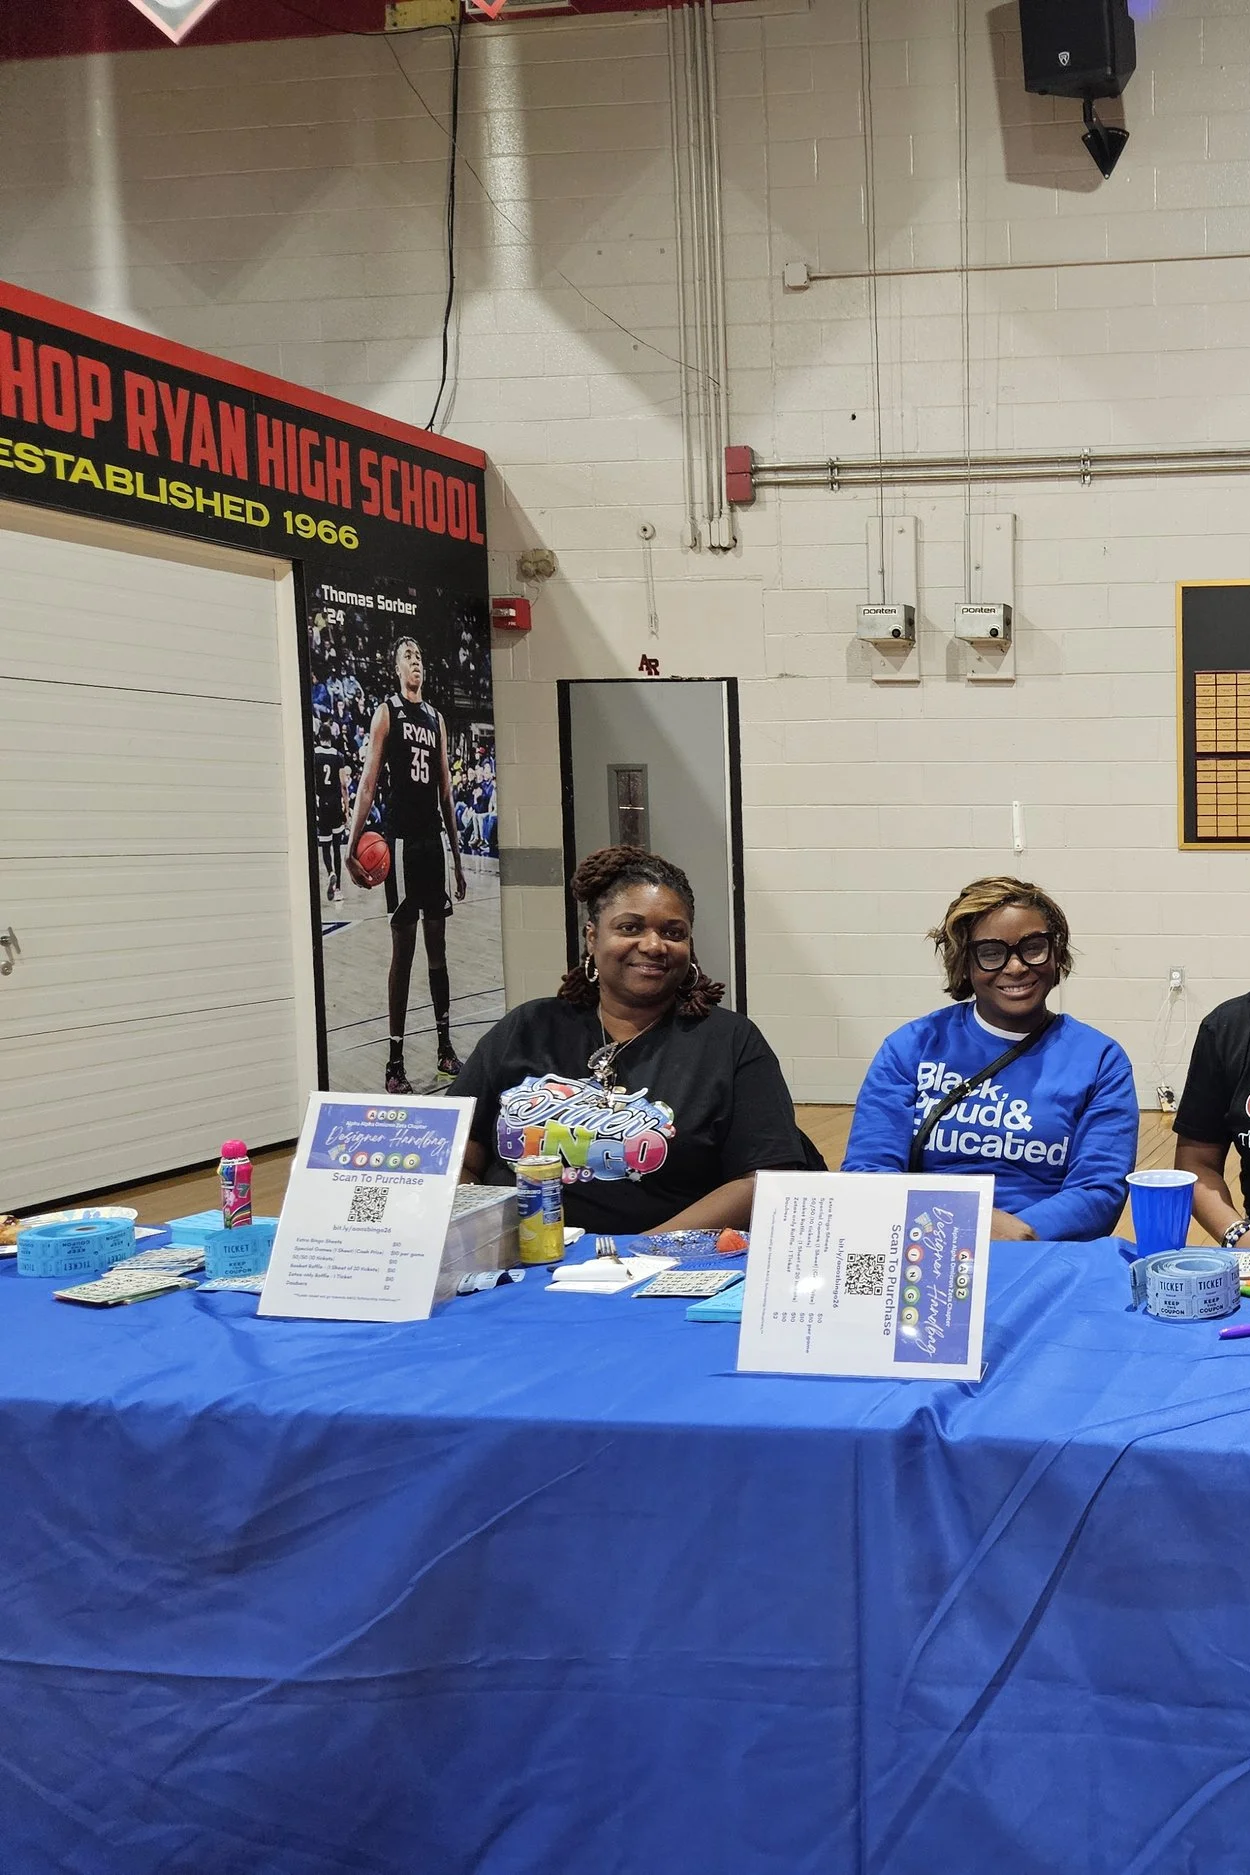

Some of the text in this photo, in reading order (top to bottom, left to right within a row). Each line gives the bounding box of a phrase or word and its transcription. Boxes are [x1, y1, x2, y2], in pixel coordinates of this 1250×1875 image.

[124, 370, 248, 481] RYAN
[256, 413, 352, 510] HIGH
[359, 447, 484, 545] SCHOOL
[0, 437, 359, 550] ESTABLISHED 1966
[321, 584, 418, 616] Thomas Sorber
[402, 722, 437, 749] RYAN
[323, 764, 332, 785] 2
[410, 747, 430, 784] 35
[325, 1126, 385, 1152] Designer
[236, 1183, 250, 1198] 7
[332, 1173, 424, 1186] Scan To Purchase
[224, 1244, 249, 1254] TICKET
[64, 1260, 91, 1268] TICKET
[882, 1224, 902, 1336] Scan To Purchase
[918, 1206, 954, 1358] Designer Handbag
[1160, 1281, 1184, 1292] TICKET
[1198, 1278, 1222, 1290] TICKET
[1200, 1304, 1224, 1314] COUPON
